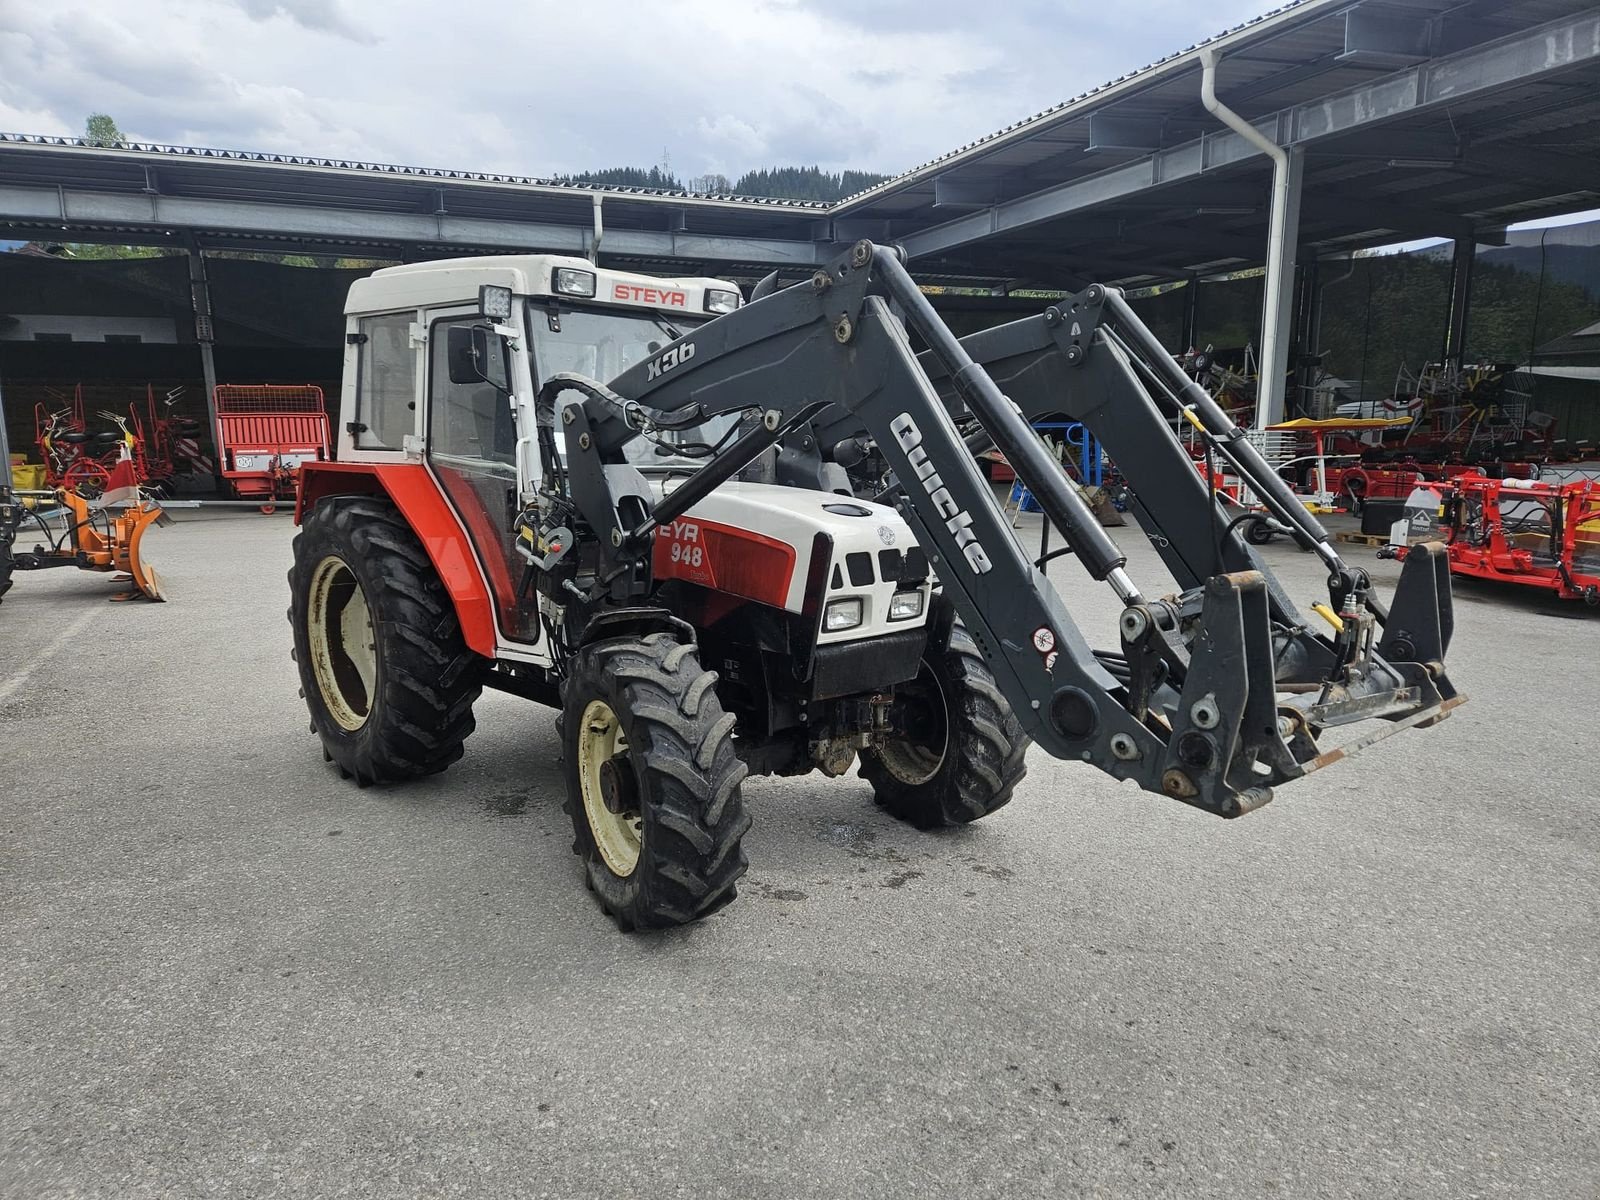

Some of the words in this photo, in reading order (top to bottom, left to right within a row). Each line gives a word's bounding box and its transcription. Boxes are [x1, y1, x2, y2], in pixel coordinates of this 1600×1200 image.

[614, 284, 686, 307] STEYR
[647, 342, 695, 382] X36
[889, 411, 993, 575] Quicke
[660, 521, 699, 542] EYR
[671, 543, 702, 567] 948
